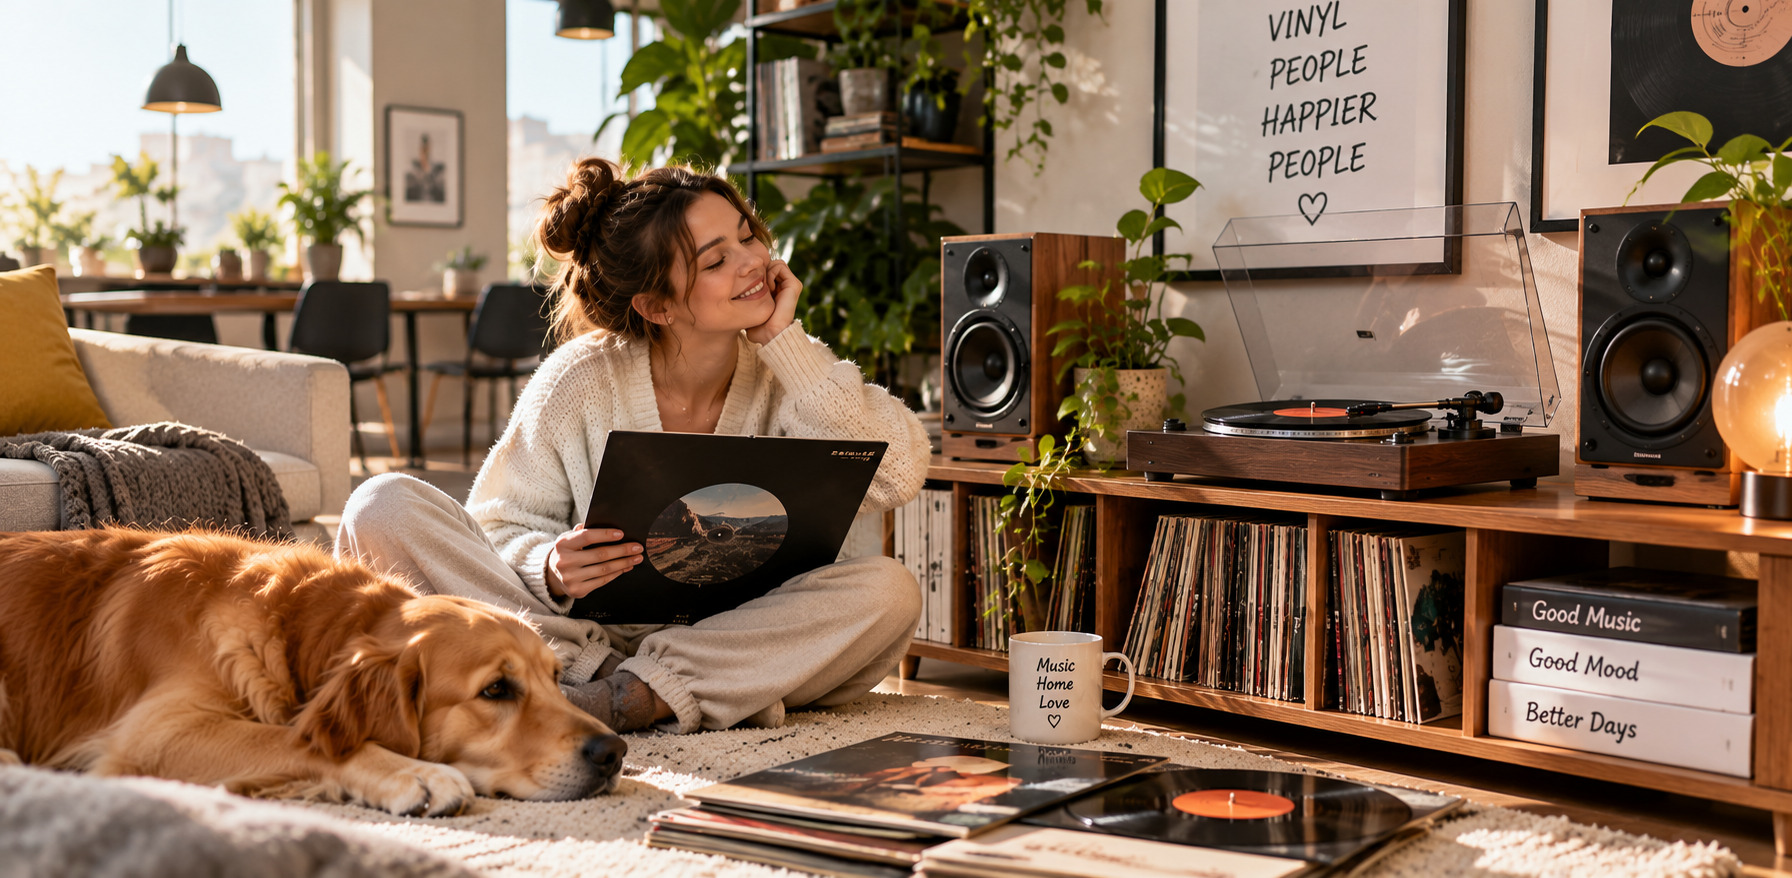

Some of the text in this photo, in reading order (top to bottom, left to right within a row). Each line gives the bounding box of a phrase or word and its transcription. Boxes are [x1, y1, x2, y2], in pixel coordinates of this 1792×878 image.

[1269, 1, 1347, 41] VINYL
[1270, 44, 1368, 90] PEOPLE
[1261, 91, 1377, 137] HAPPIER
[1268, 142, 1367, 183] PEOPLE
[1532, 599, 1642, 633] Good Music
[1036, 657, 1076, 673] Music
[1036, 675, 1074, 691] Home
[1529, 647, 1640, 682] Good Mood
[1039, 694, 1070, 709] Love
[1526, 701, 1637, 745] Better Days
